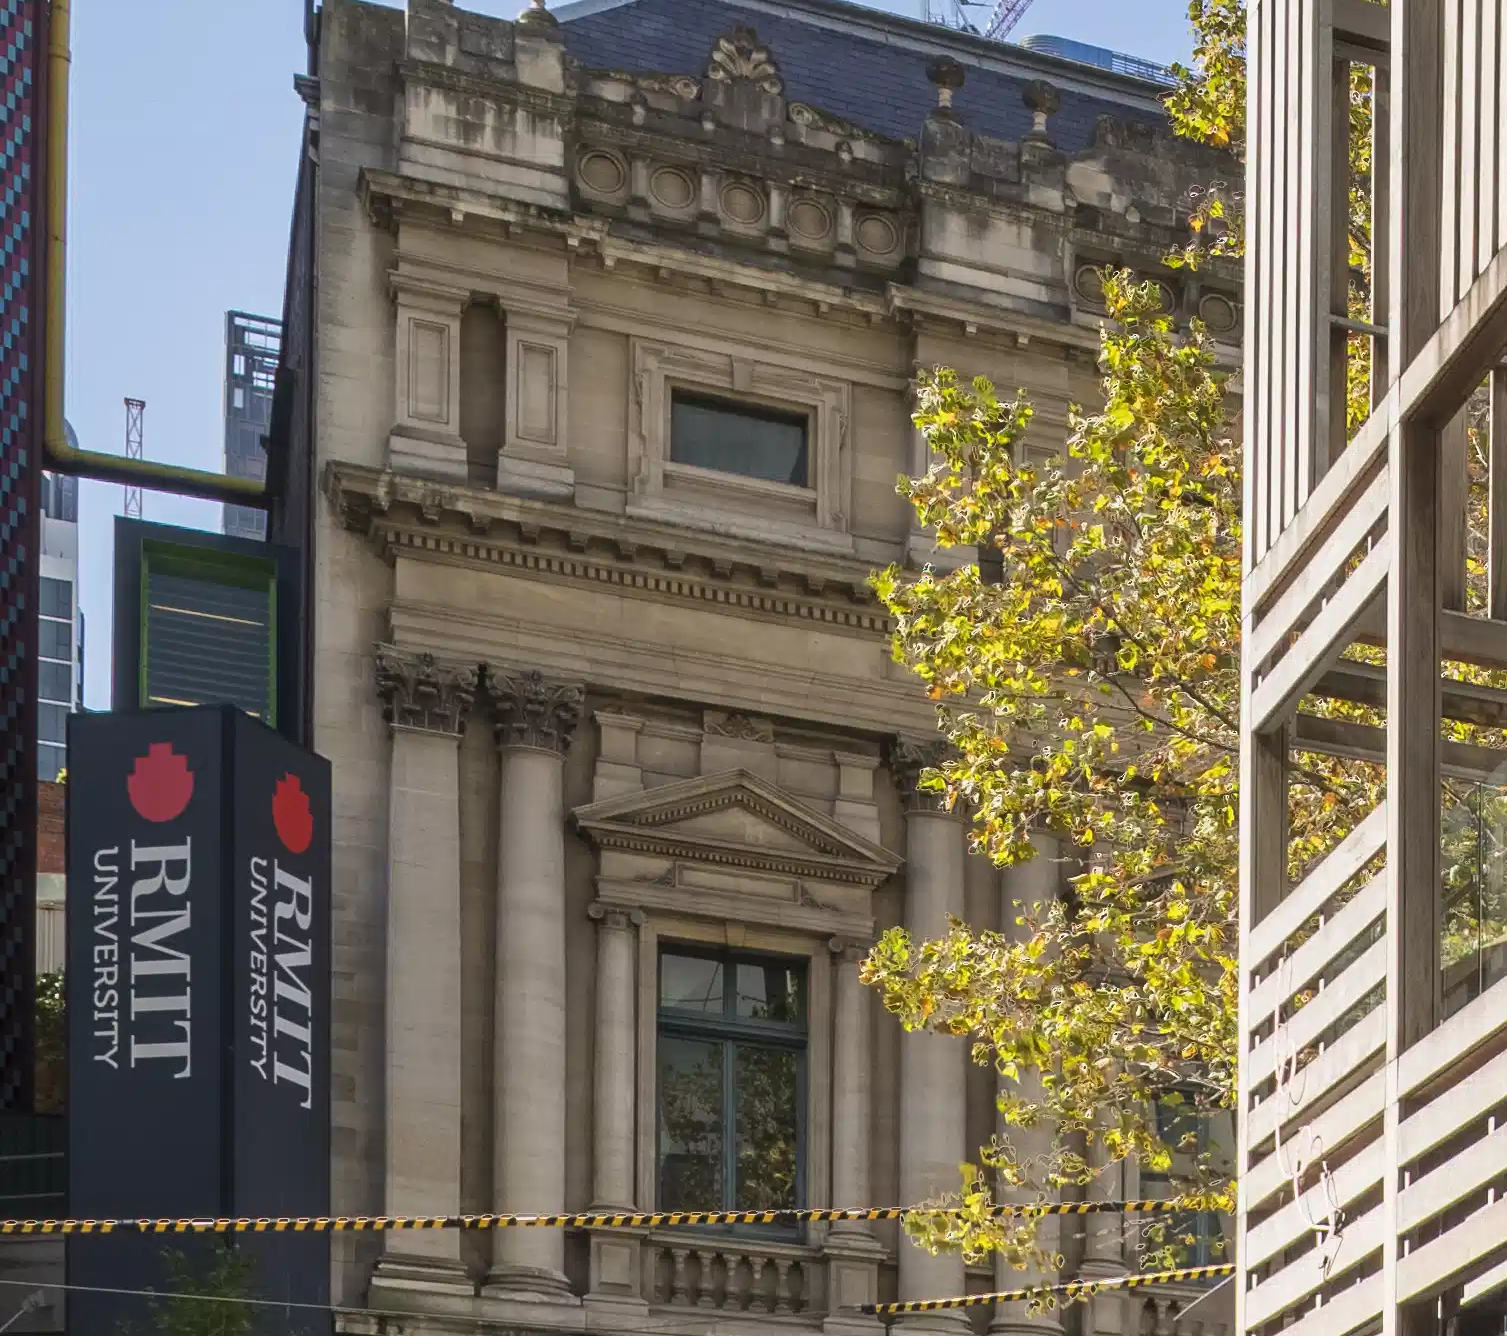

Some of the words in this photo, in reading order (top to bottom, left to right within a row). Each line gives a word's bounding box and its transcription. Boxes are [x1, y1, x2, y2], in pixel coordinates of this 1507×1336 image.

[94, 847, 118, 1069] UNIVERSITY
[131, 836, 191, 1078] RMIT
[250, 857, 268, 1079] UNIVERSITY
[274, 859, 312, 1109] RMIT
